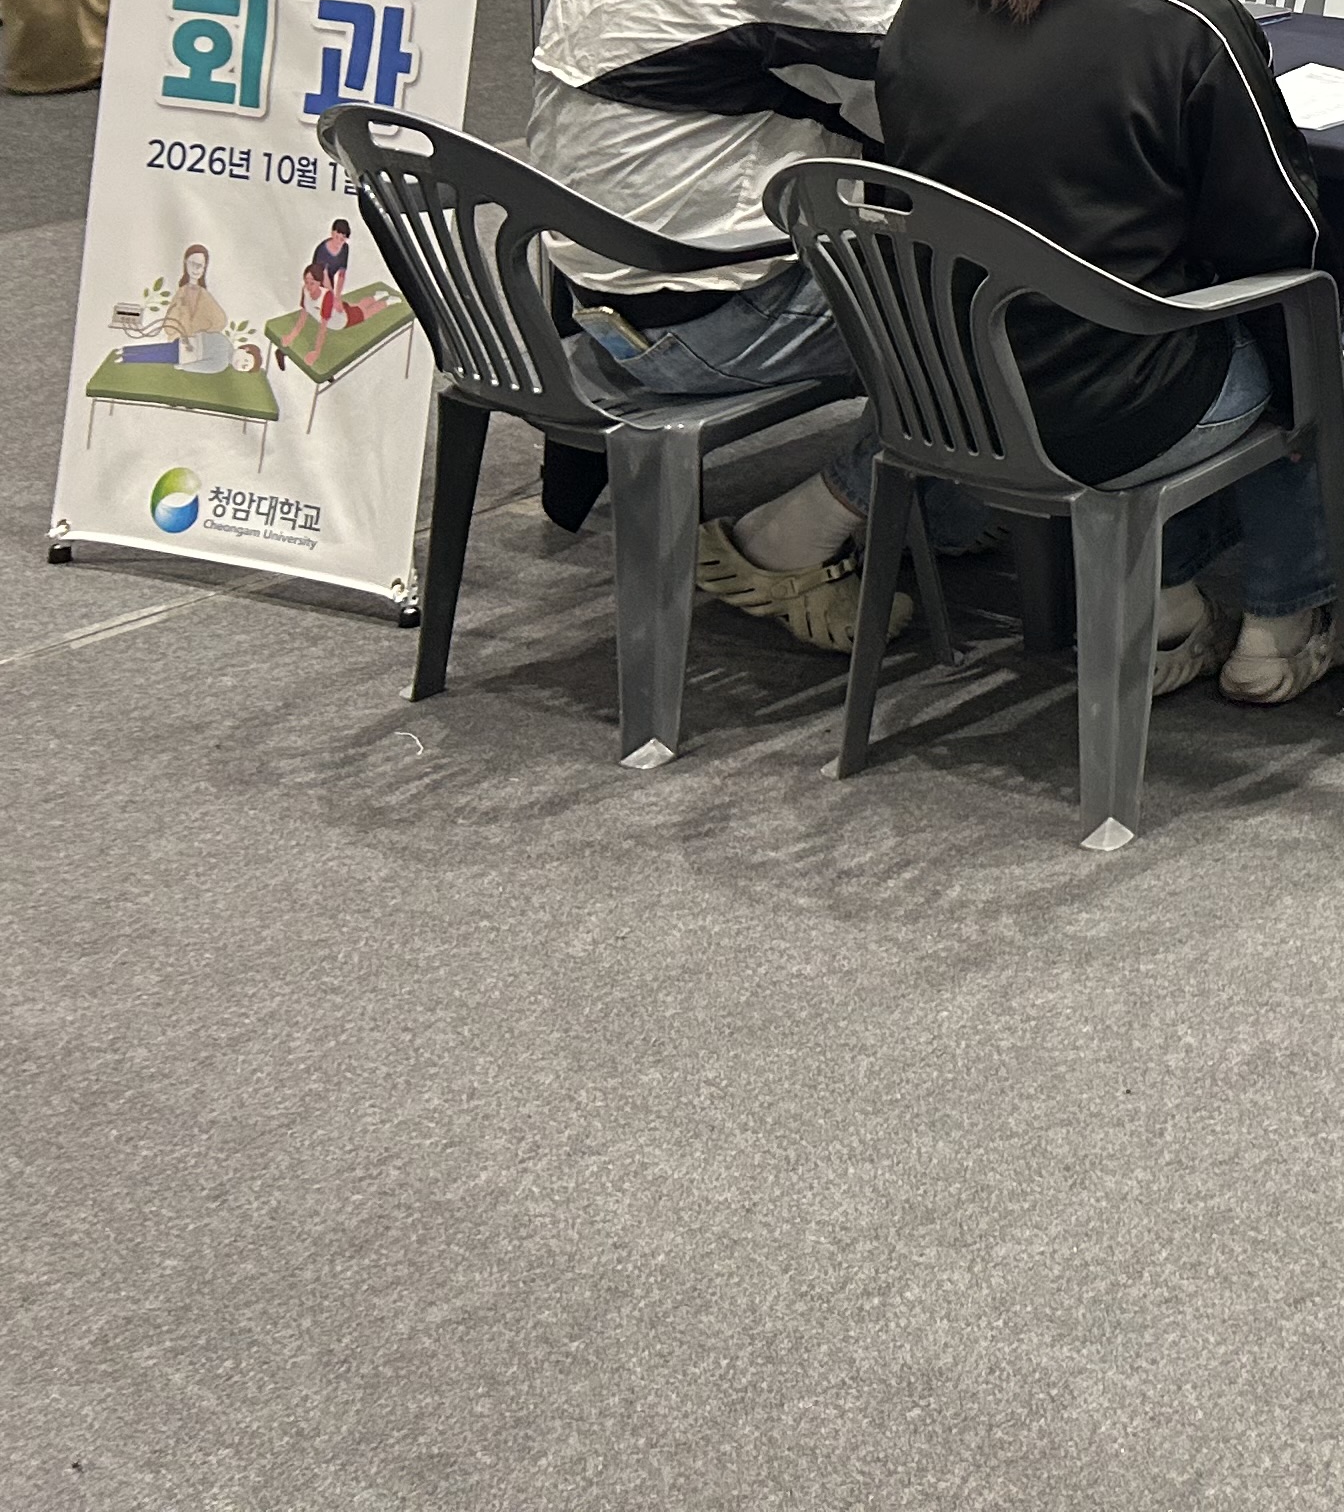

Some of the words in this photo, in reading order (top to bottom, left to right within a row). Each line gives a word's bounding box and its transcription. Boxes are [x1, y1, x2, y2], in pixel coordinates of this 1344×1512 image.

[147, 139, 251, 180] 2026년
[262, 152, 318, 190] 10월
[208, 486, 321, 532] 청암대학교
[203, 518, 261, 538] Cheongam
[263, 528, 318, 550] University
